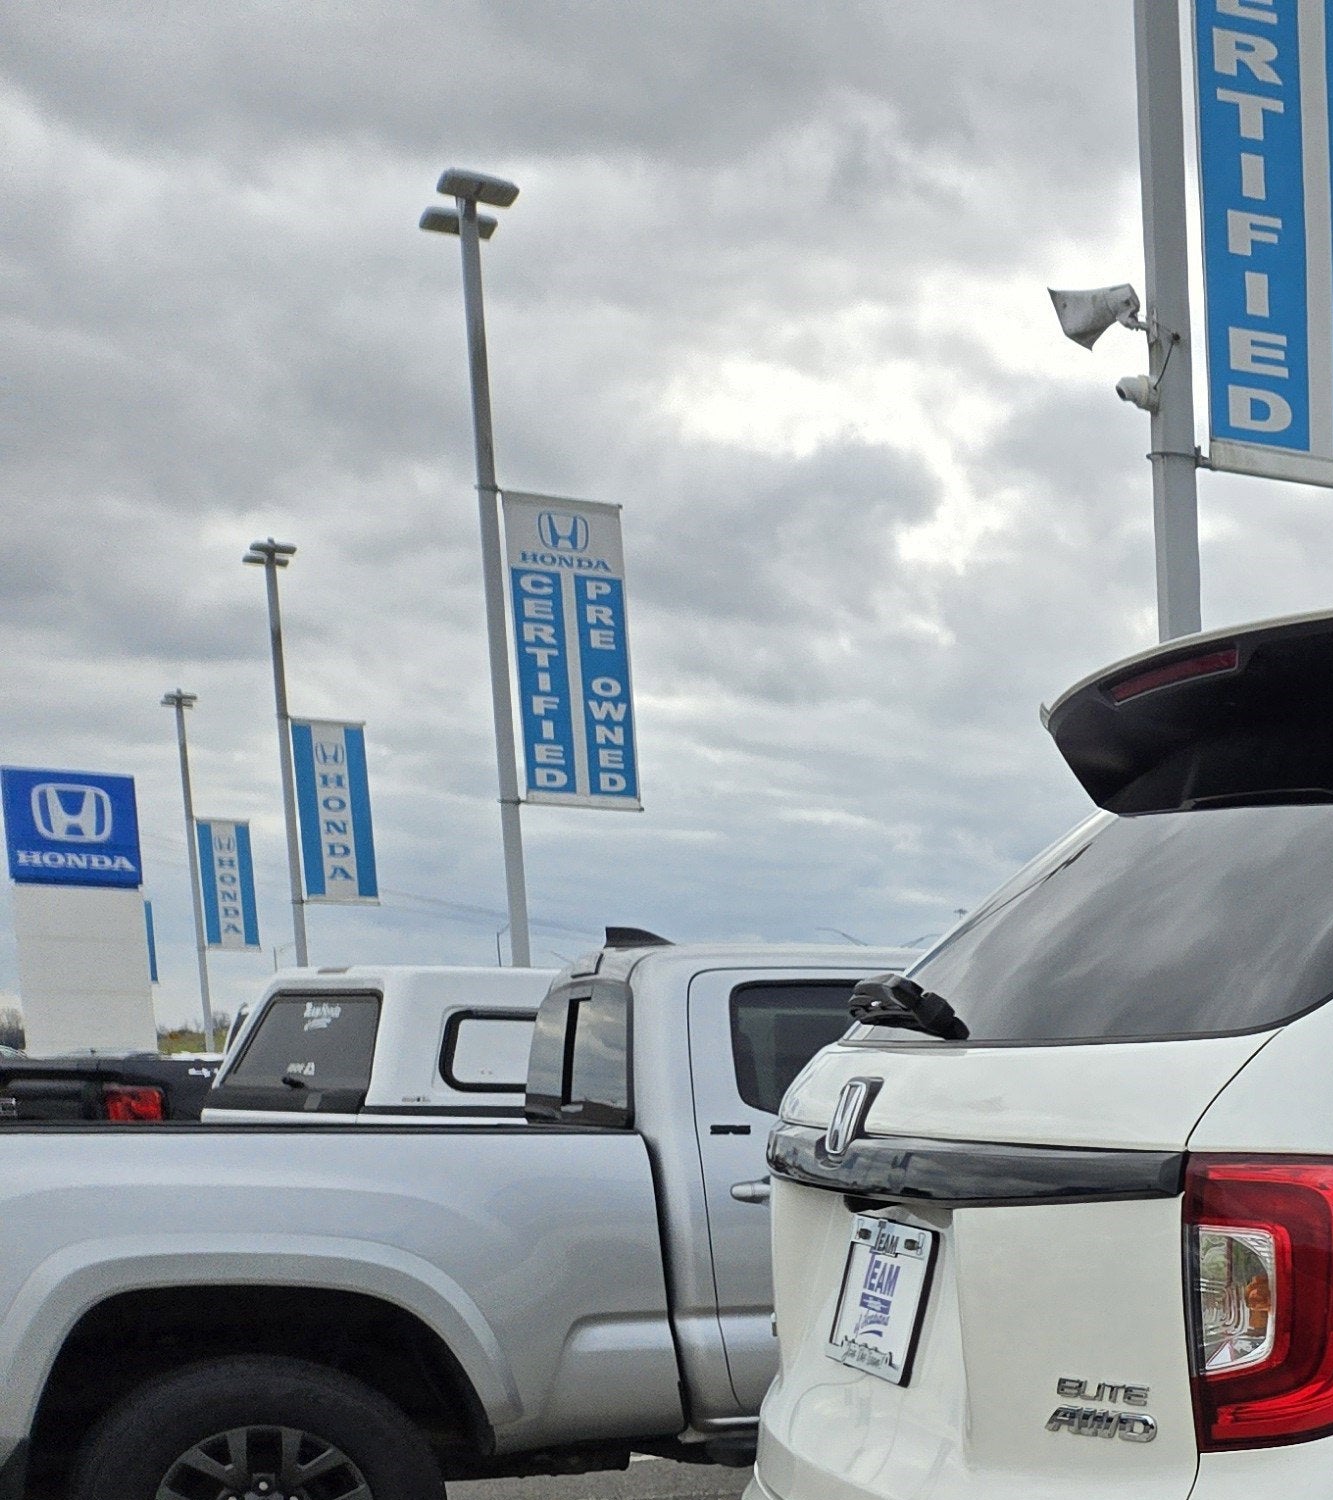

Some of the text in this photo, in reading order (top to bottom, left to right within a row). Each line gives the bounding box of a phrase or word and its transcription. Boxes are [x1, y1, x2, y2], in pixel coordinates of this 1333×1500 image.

[520, 551, 612, 573] HONDA
[519, 572, 568, 788] CERTIFIED
[586, 579, 628, 793] PRE OWNED
[319, 773, 355, 882] HONDA
[17, 850, 136, 872] HONDA
[217, 858, 243, 936] HONDA
[863, 1250, 901, 1298] TEAM
[1056, 1377, 1150, 1407] ELITE
[1044, 1403, 1158, 1443] AWD
